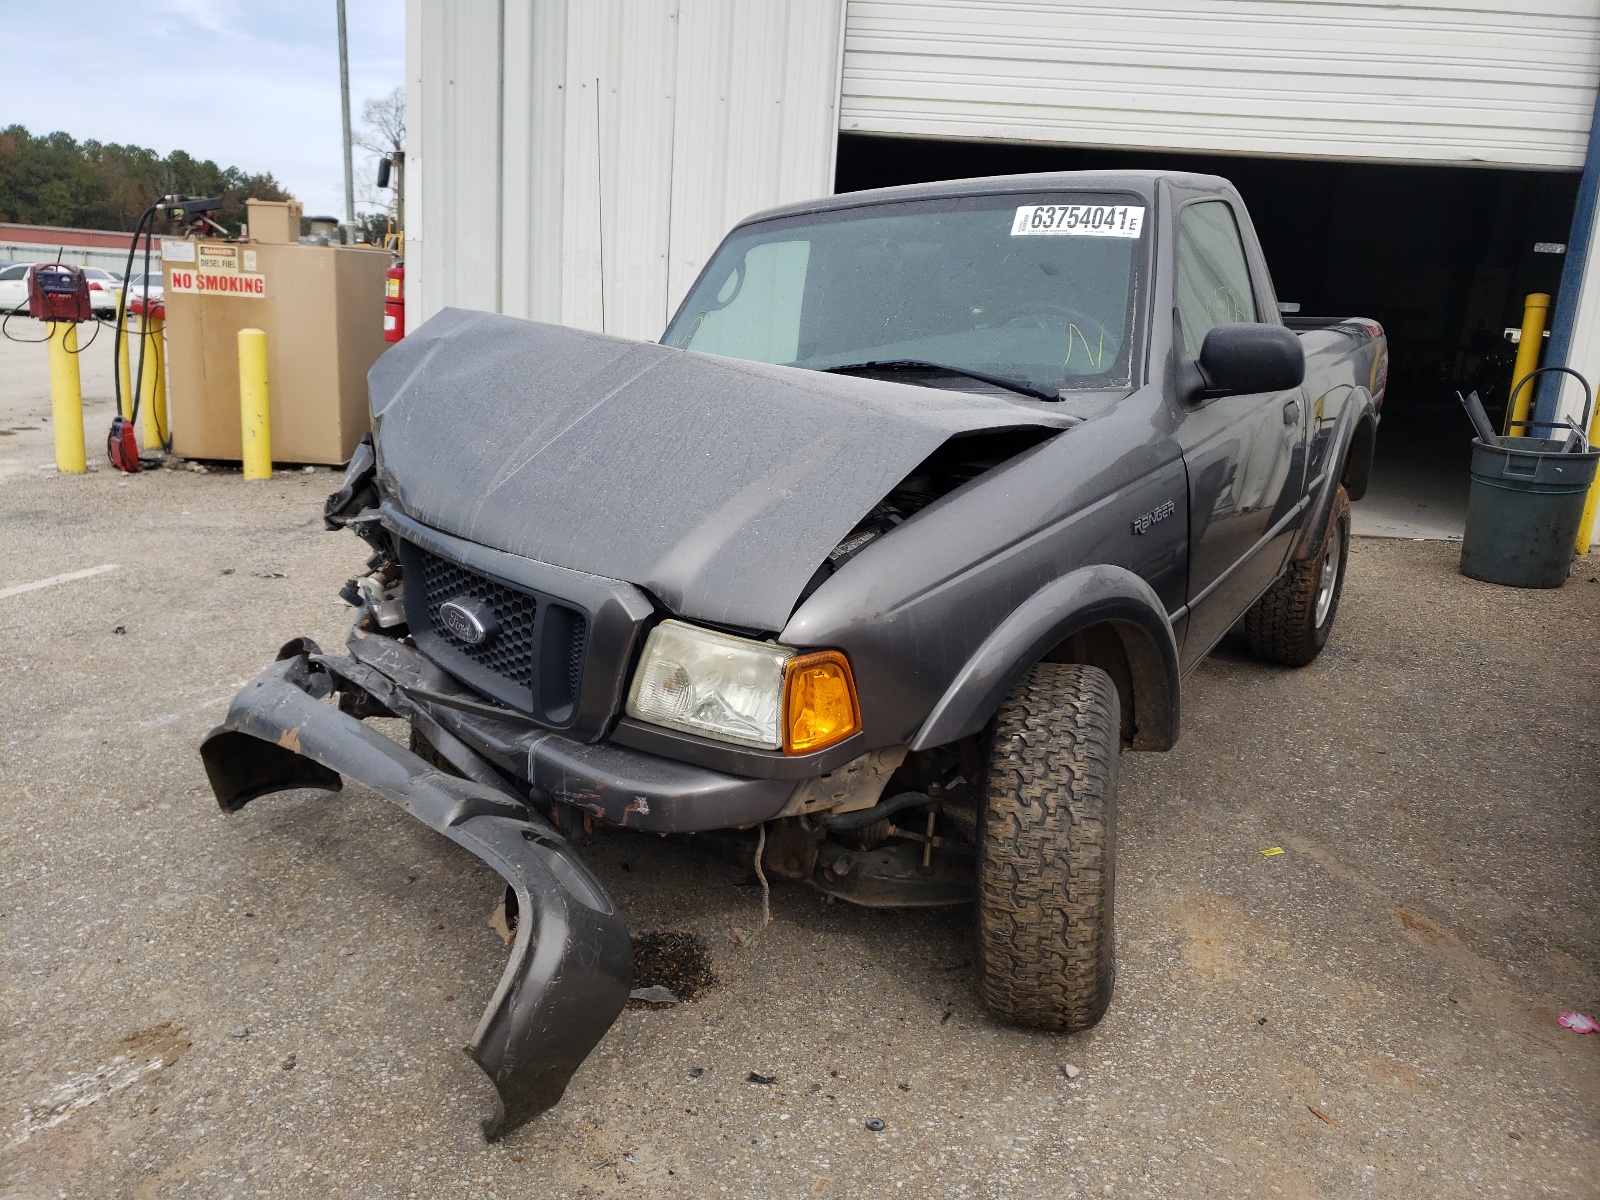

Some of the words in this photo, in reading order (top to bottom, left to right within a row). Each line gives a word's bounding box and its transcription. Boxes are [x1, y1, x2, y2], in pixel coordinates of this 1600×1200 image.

[1031, 206, 1128, 230] 63754041
[1128, 218, 1138, 231] E
[200, 259, 220, 268] DIESEL
[222, 260, 236, 268] FUEL
[172, 272, 192, 289] NO
[196, 274, 264, 294] SMOKING
[1131, 501, 1175, 534] RANGER
[448, 609, 471, 637] Ford
